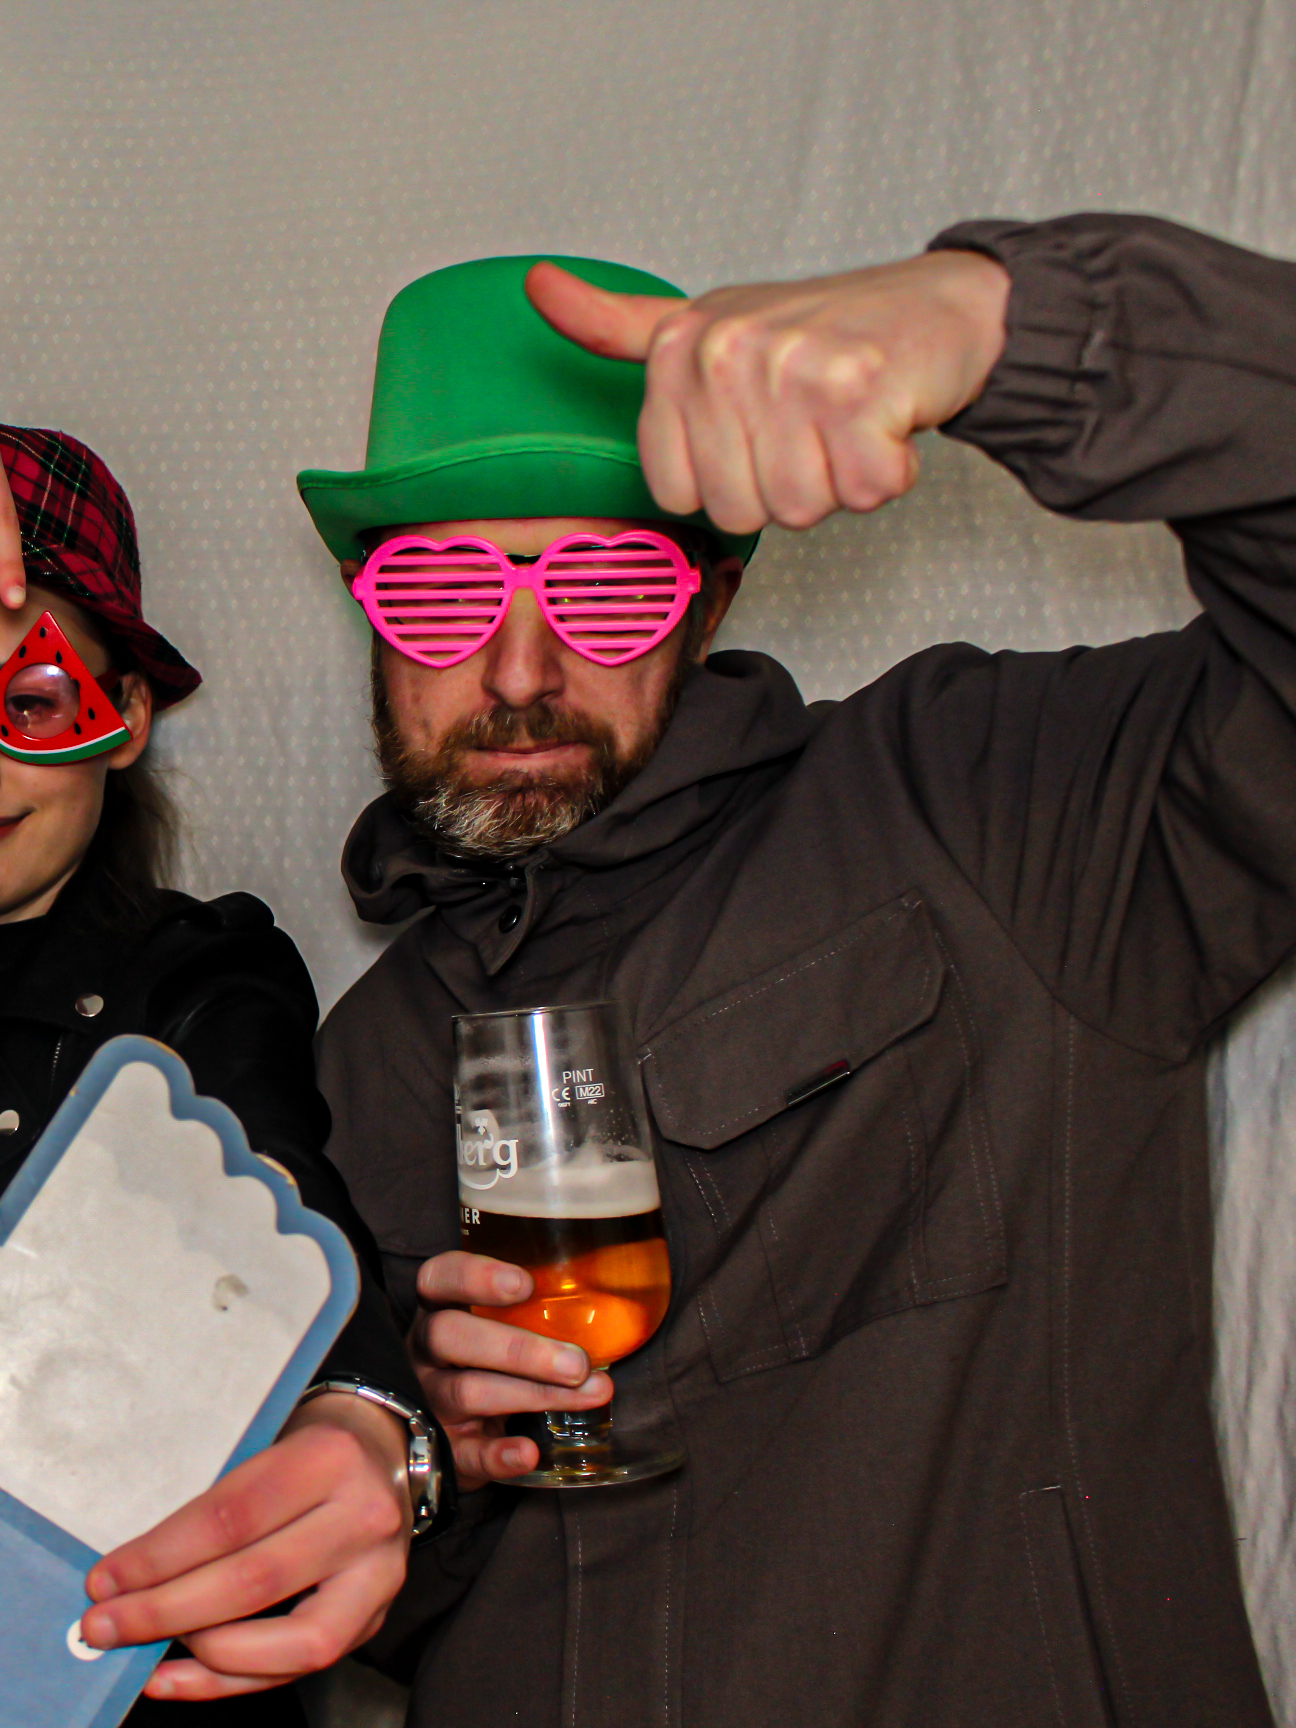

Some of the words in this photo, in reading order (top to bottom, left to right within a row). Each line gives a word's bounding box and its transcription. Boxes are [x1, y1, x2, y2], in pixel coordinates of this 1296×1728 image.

[562, 1068, 594, 1084] PINT
[551, 1087, 571, 1102] CE
[579, 1085, 602, 1098] M22
[461, 1207, 481, 1225] ER
